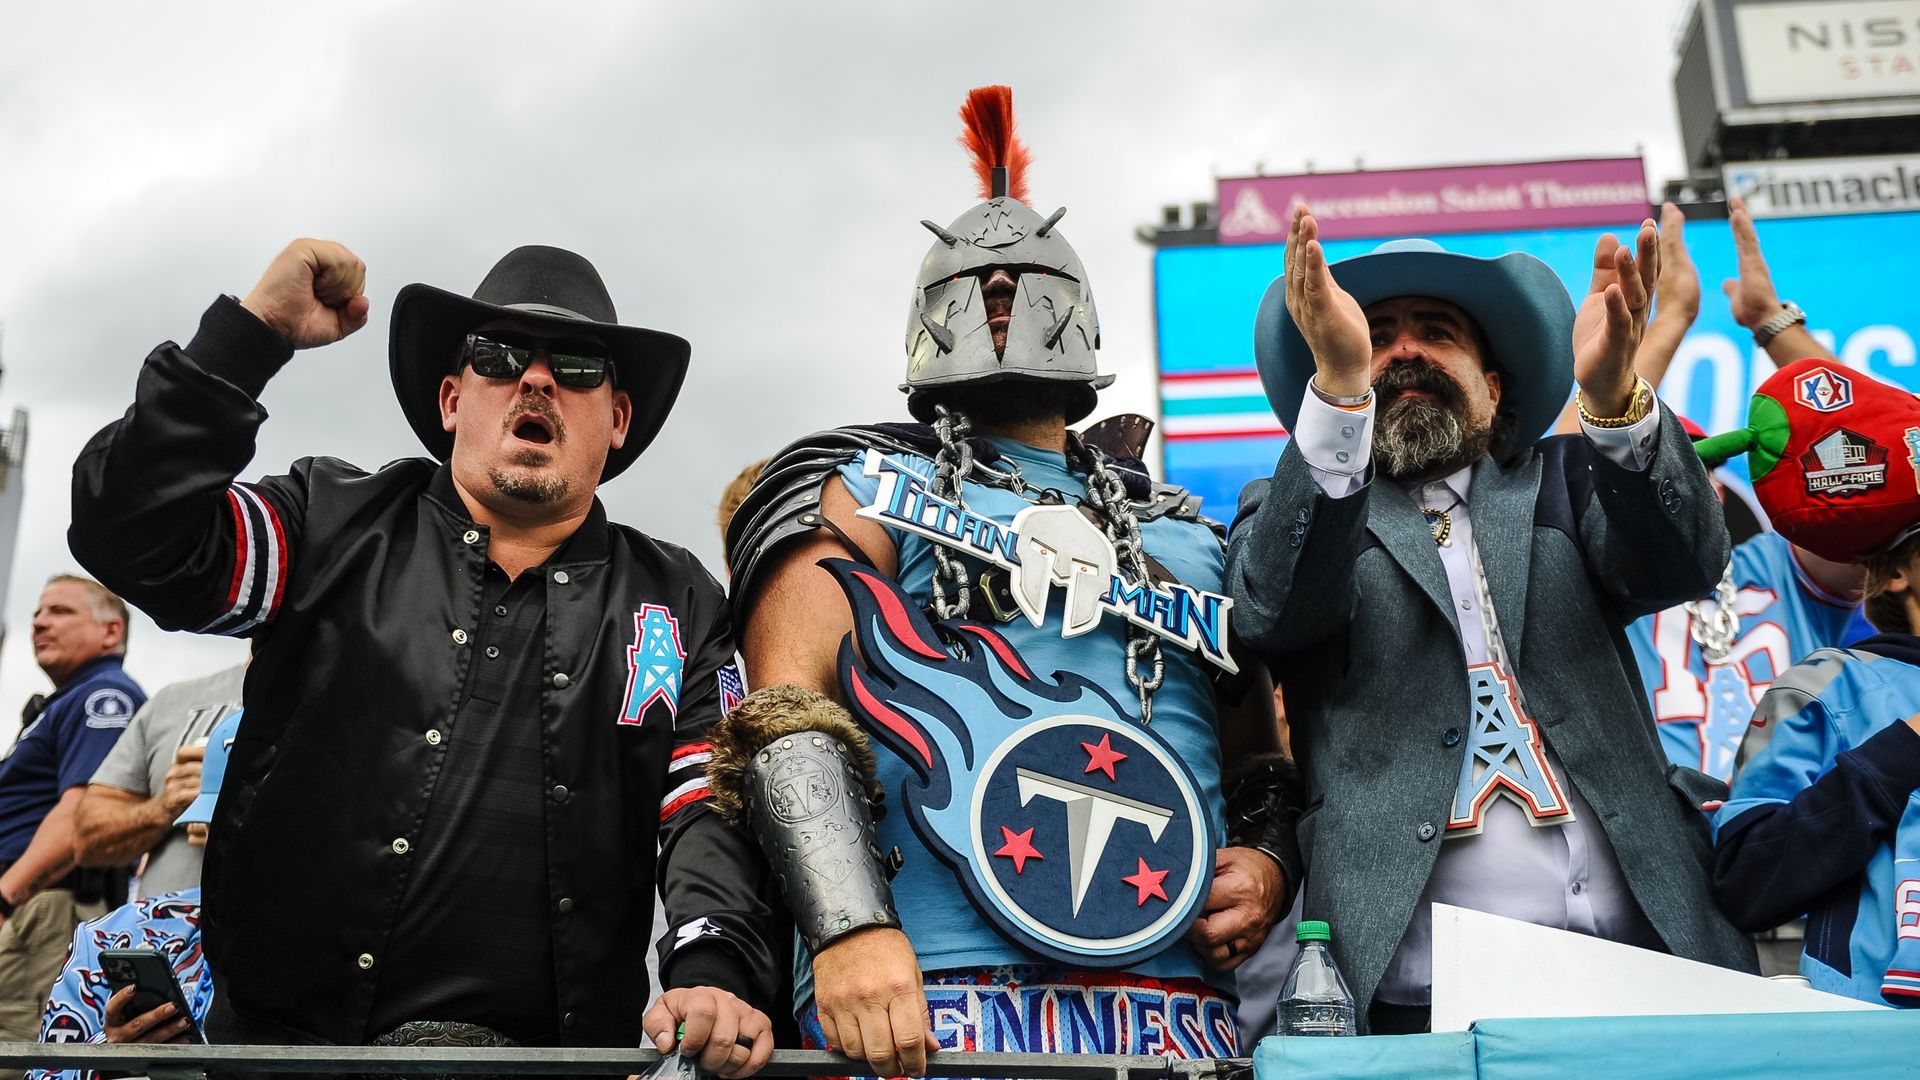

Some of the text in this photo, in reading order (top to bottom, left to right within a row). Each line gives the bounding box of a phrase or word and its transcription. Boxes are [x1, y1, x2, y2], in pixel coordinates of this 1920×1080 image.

[1788, 17, 1920, 50] NIS
[1440, 182, 1523, 214] Saint
[1522, 178, 1647, 209] Thomas
[1810, 476, 1842, 488] HALL
[1850, 471, 1882, 484] FAME
